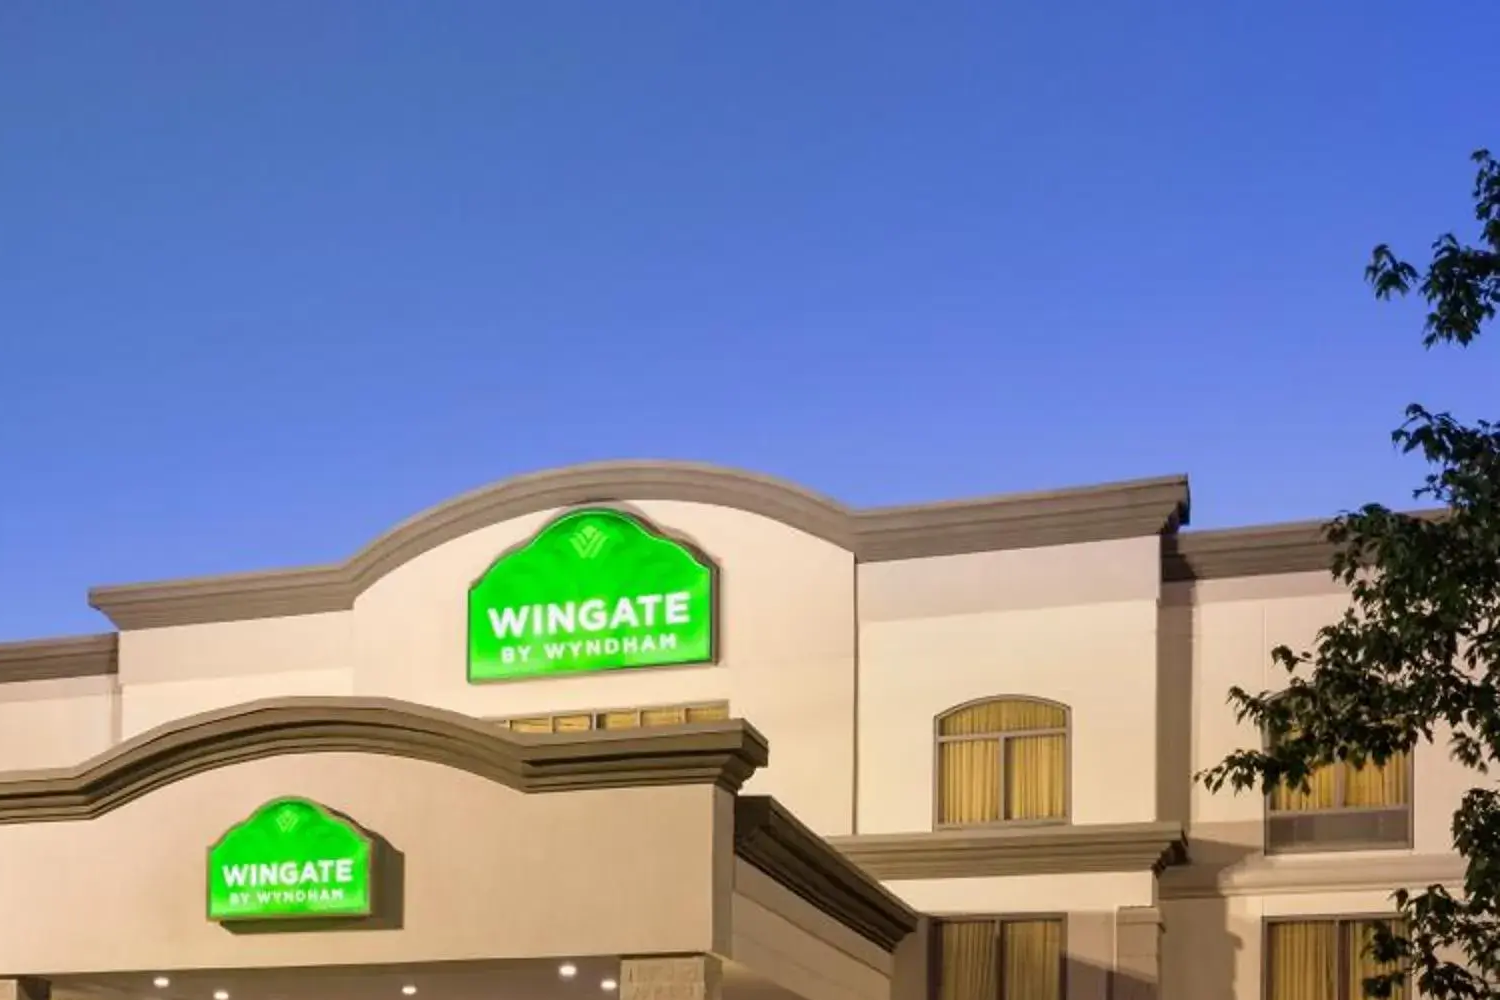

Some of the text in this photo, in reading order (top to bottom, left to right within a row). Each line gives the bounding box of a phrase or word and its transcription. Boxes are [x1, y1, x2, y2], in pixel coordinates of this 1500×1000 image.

[487, 591, 691, 639] WINGATE
[501, 633, 677, 663] BY WYNDHAM
[222, 858, 355, 887] WINGATE
[229, 888, 345, 906] BY WYNDHAM
